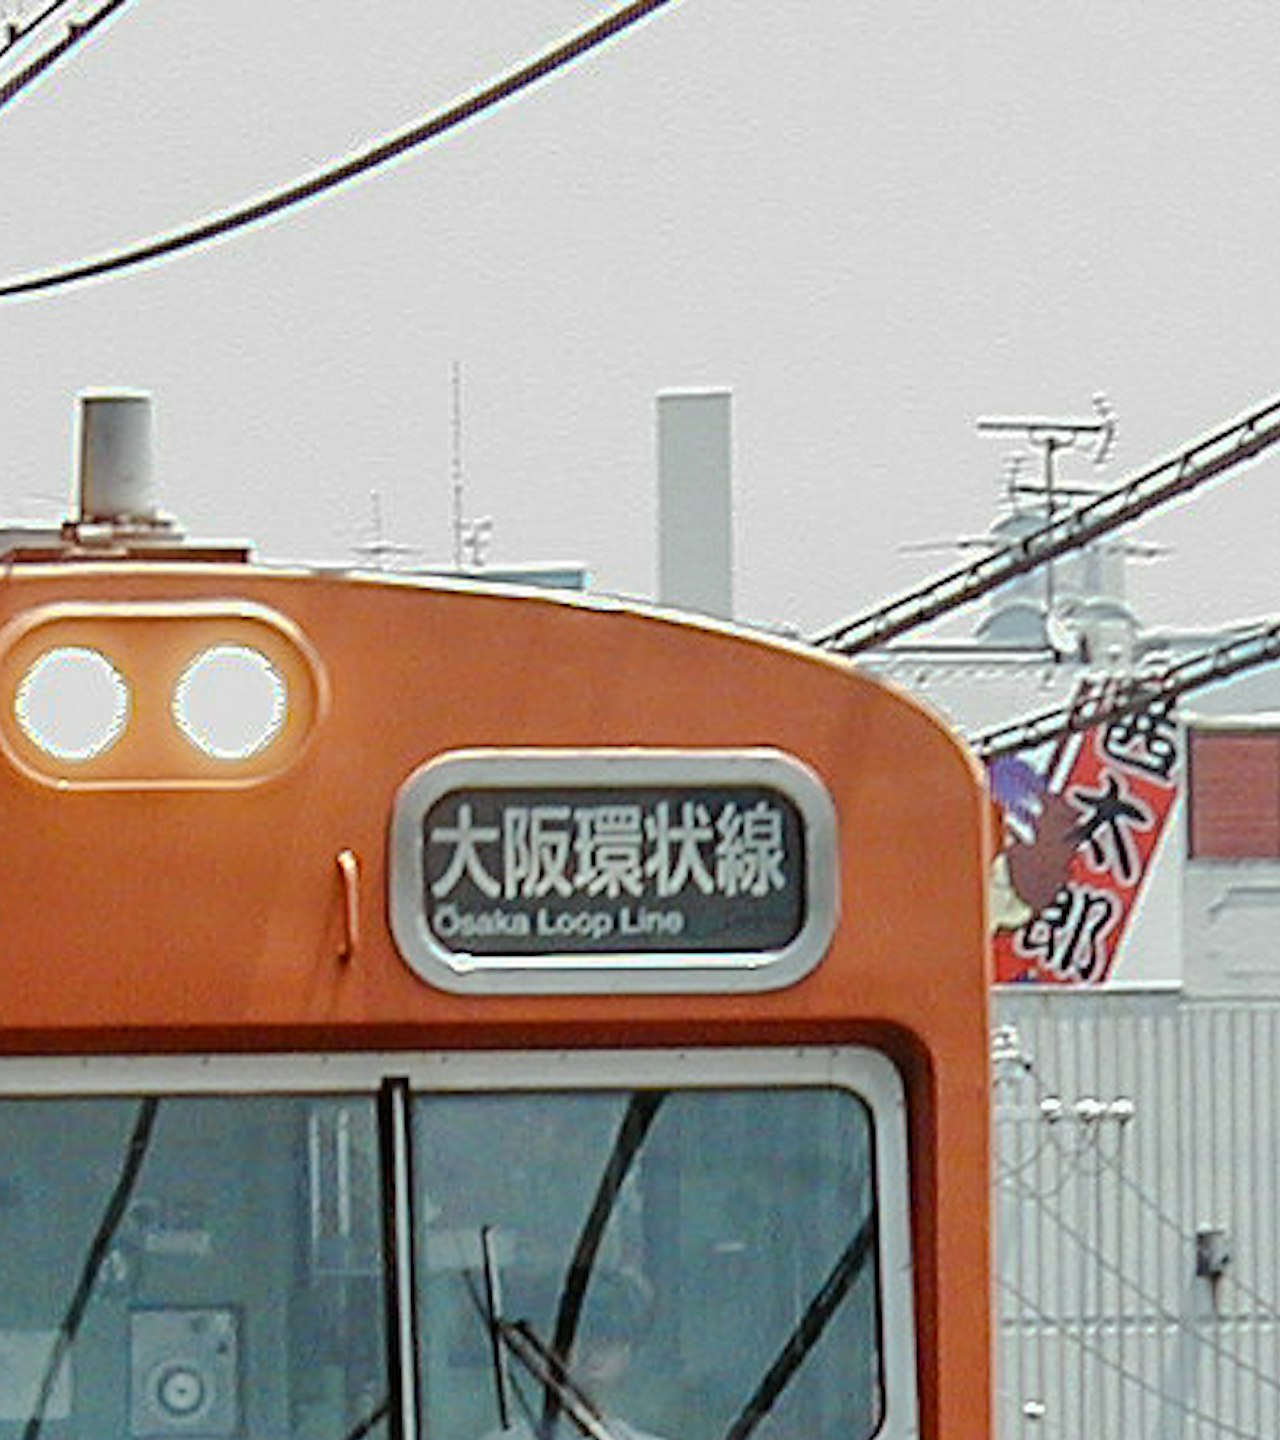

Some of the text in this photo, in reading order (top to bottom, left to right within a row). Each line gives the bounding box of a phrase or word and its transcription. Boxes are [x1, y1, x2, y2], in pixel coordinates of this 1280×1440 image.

[431, 802, 785, 899] 大阪環状線
[537, 908, 615, 939] Loop
[621, 905, 686, 935] Line
